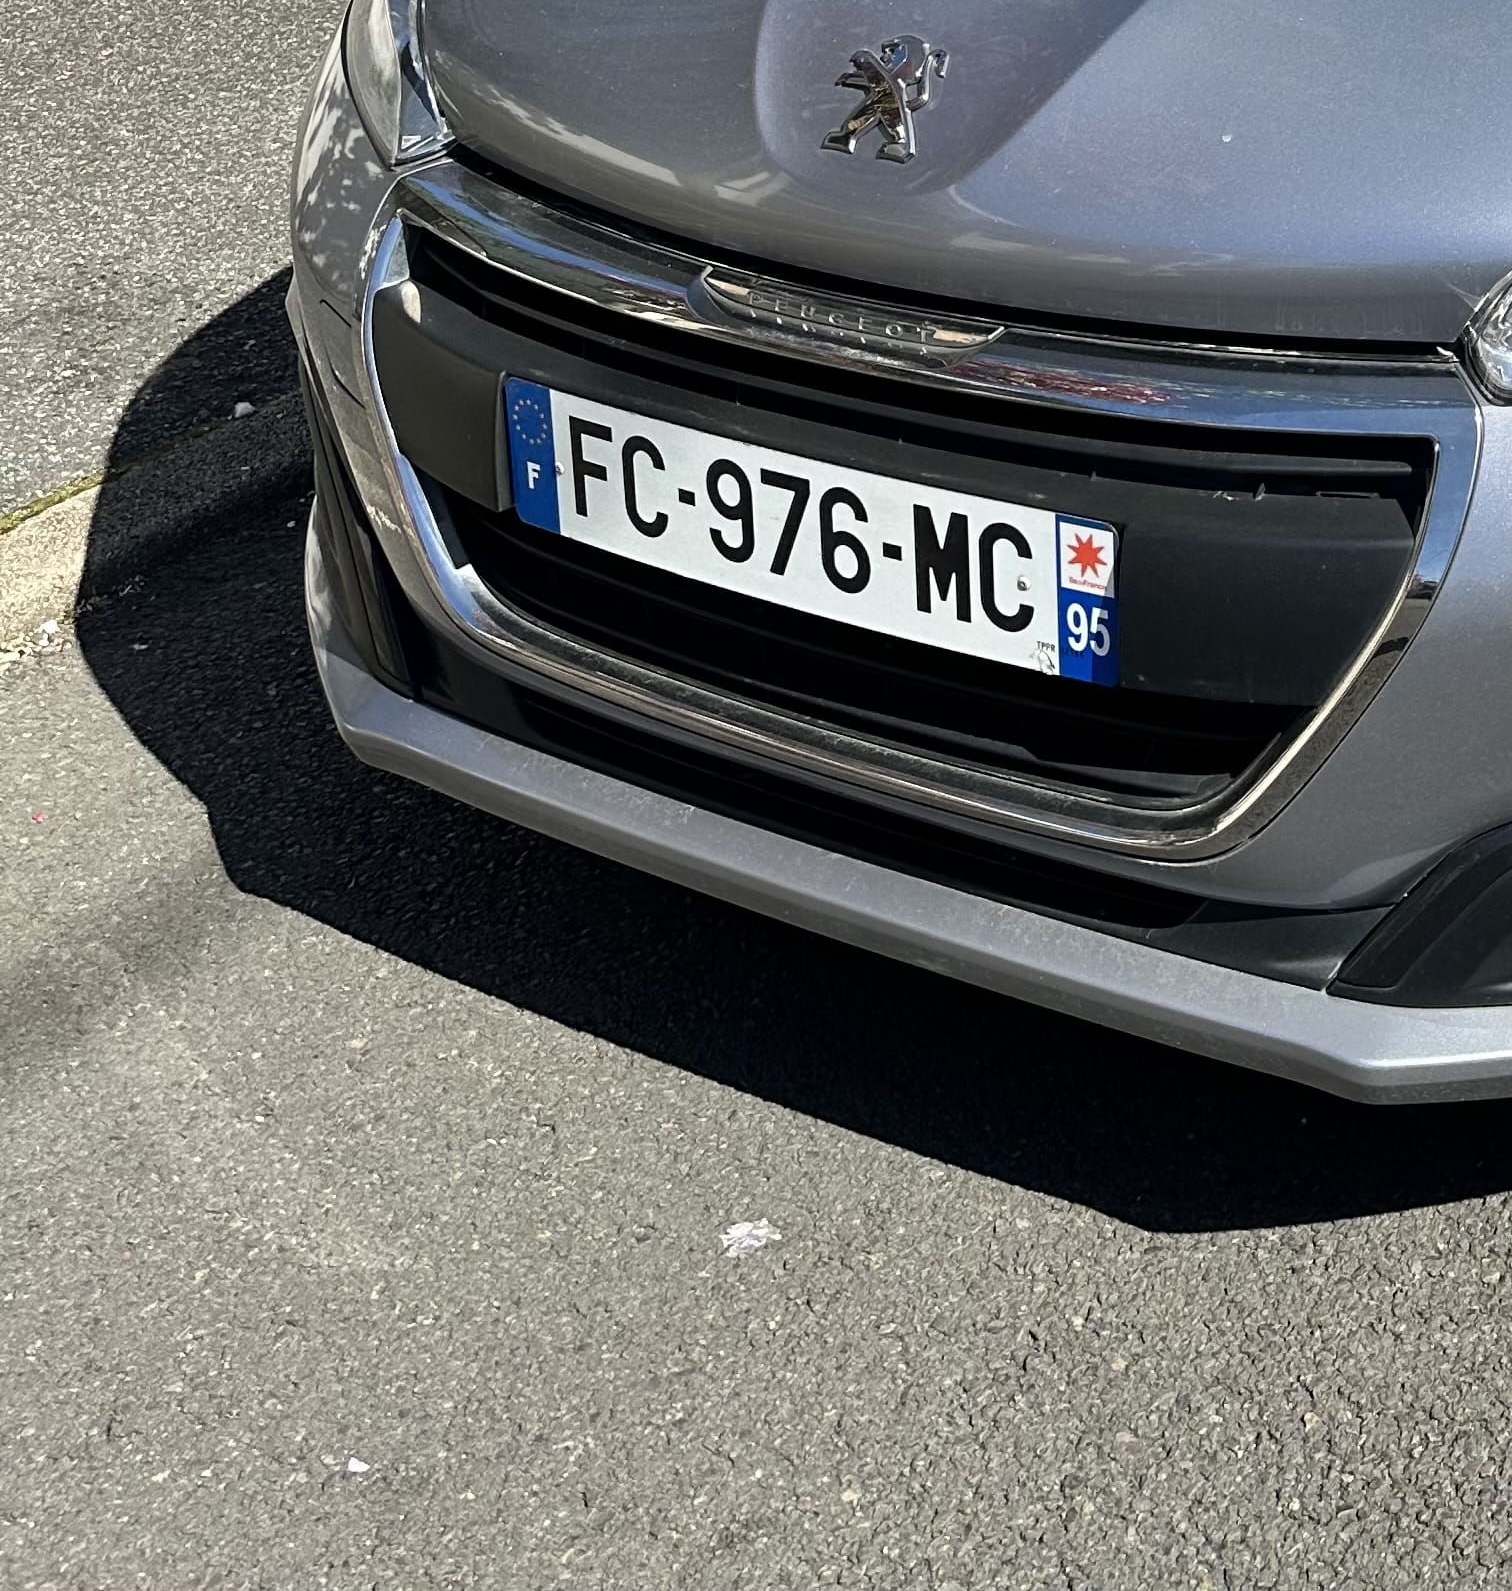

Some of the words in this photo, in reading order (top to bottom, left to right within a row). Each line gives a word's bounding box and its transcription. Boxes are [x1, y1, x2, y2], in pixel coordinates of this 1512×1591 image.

[748, 292, 937, 343] PEUGEOT
[527, 461, 541, 489] F
[569, 415, 1035, 632] FC-976-MC
[1066, 602, 1111, 656] 95
